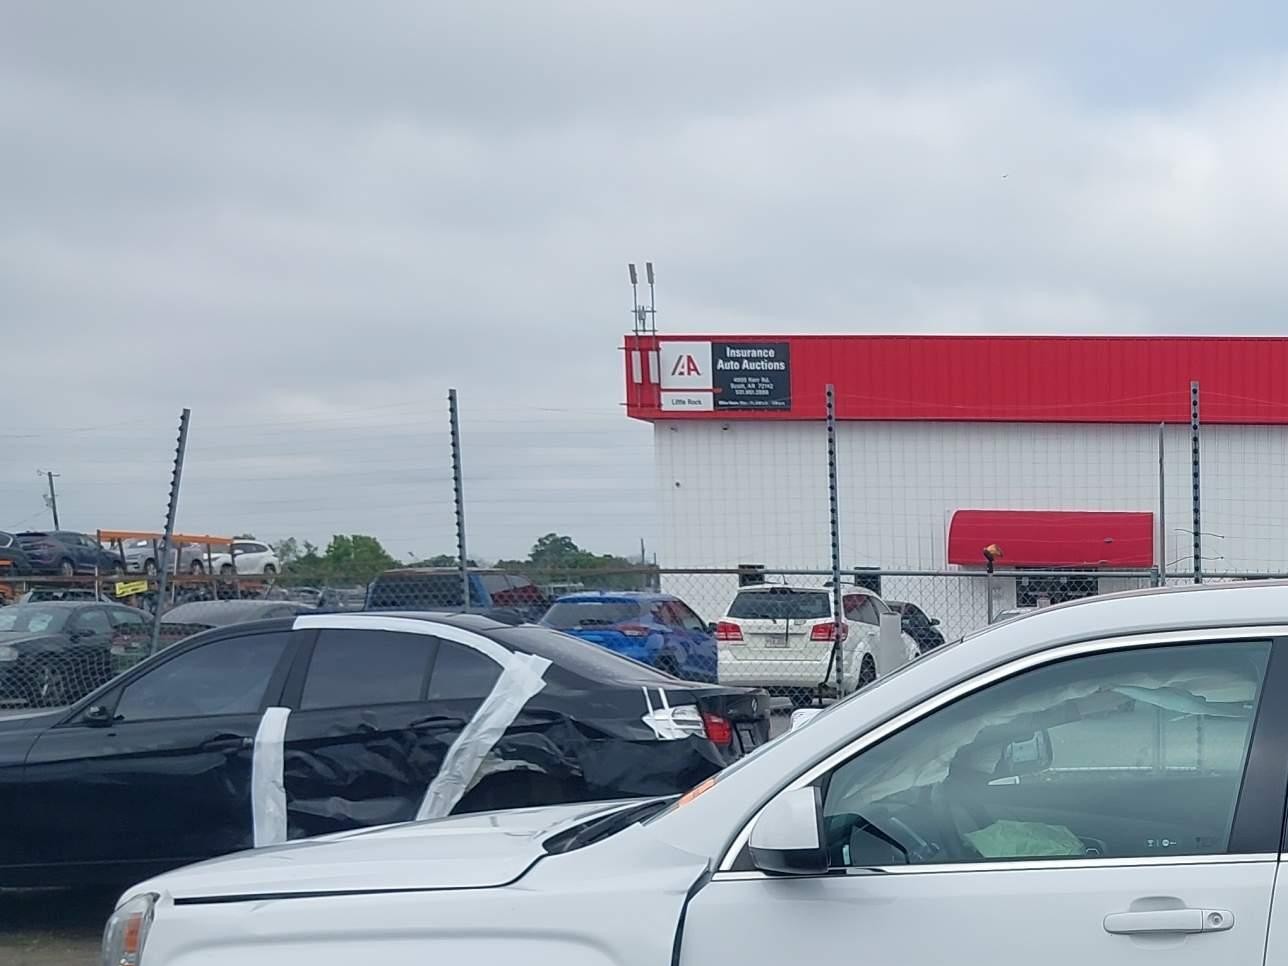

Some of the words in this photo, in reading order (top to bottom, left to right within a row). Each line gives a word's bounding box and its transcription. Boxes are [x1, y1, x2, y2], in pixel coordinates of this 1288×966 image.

[726, 346, 775, 358] Insurance
[716, 358, 740, 370] Auto
[742, 358, 786, 370] Auctions
[671, 398, 686, 406] Little
[687, 398, 702, 406] Rock
